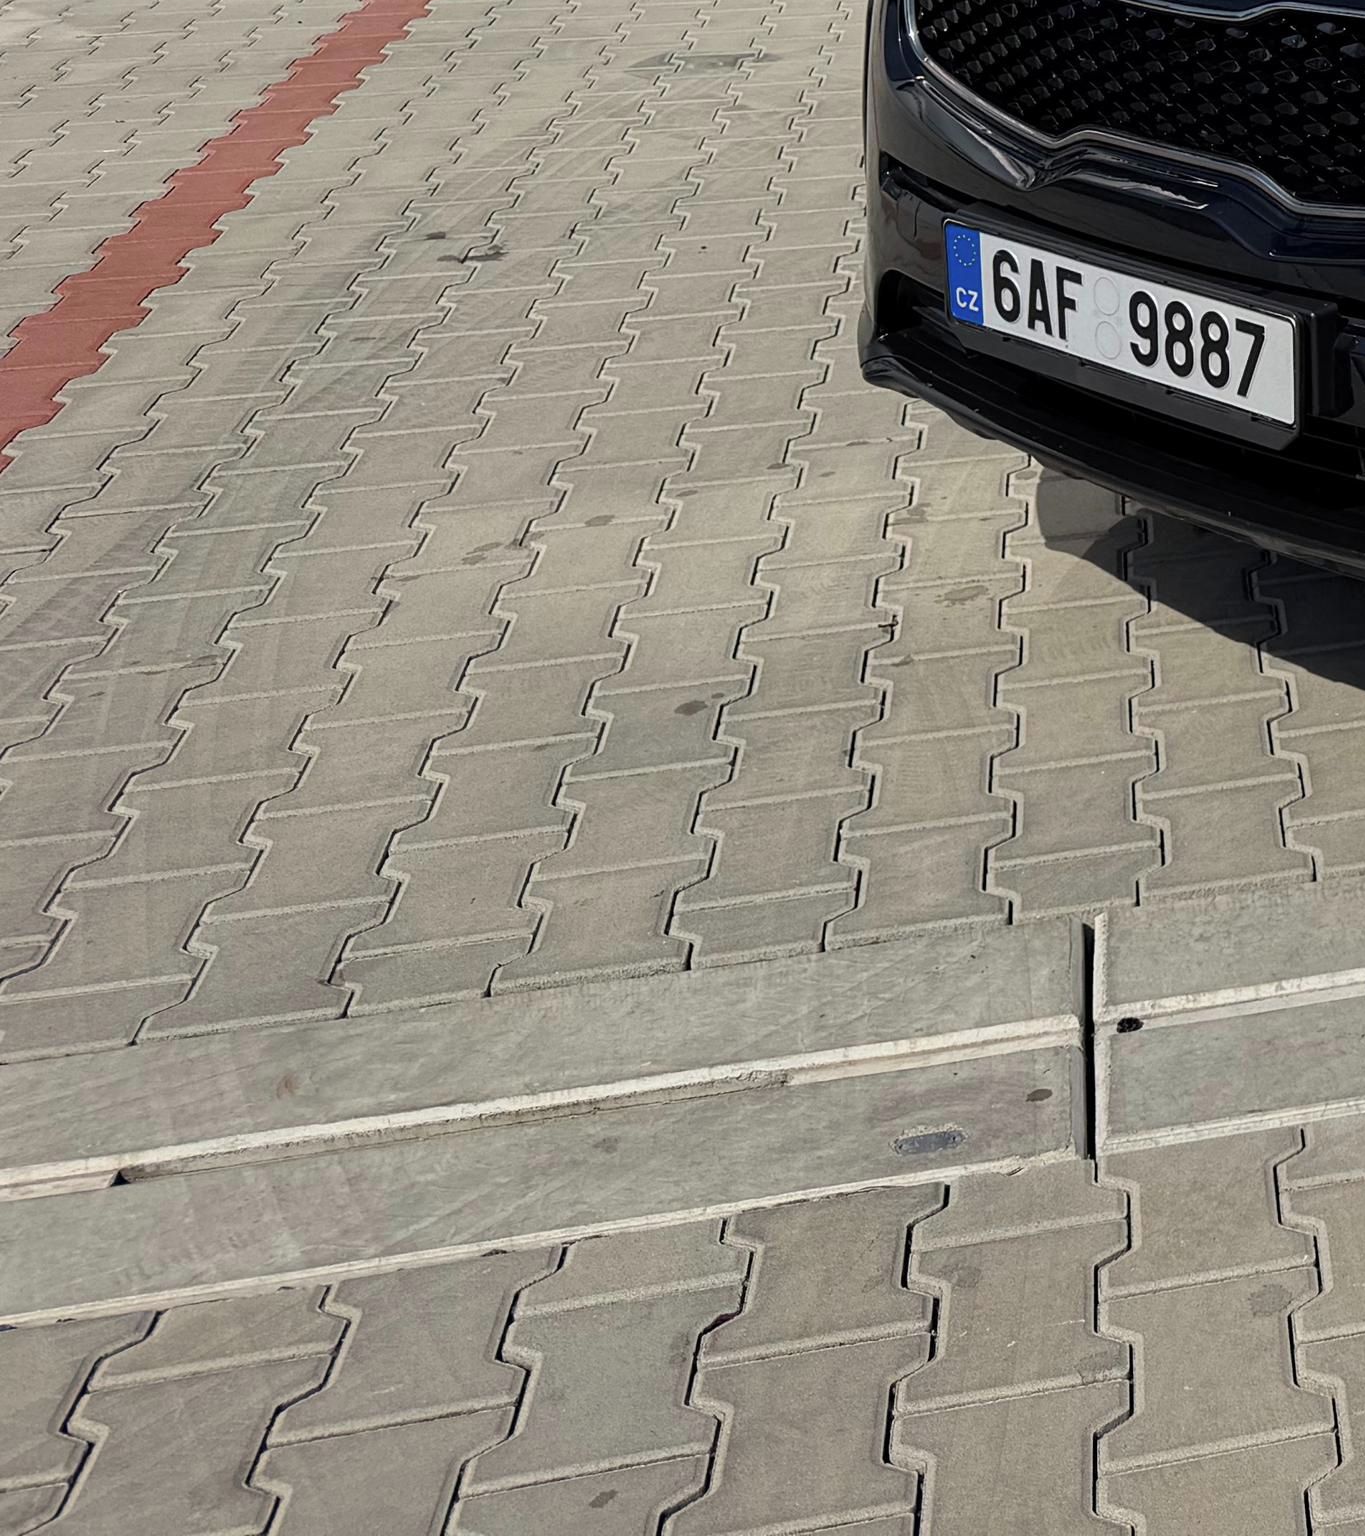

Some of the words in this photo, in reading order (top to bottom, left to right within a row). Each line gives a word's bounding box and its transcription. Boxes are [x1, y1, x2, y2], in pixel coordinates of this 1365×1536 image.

[955, 286, 980, 313] CZ
[992, 249, 1083, 341] 6AF
[1129, 290, 1265, 398] 9887
